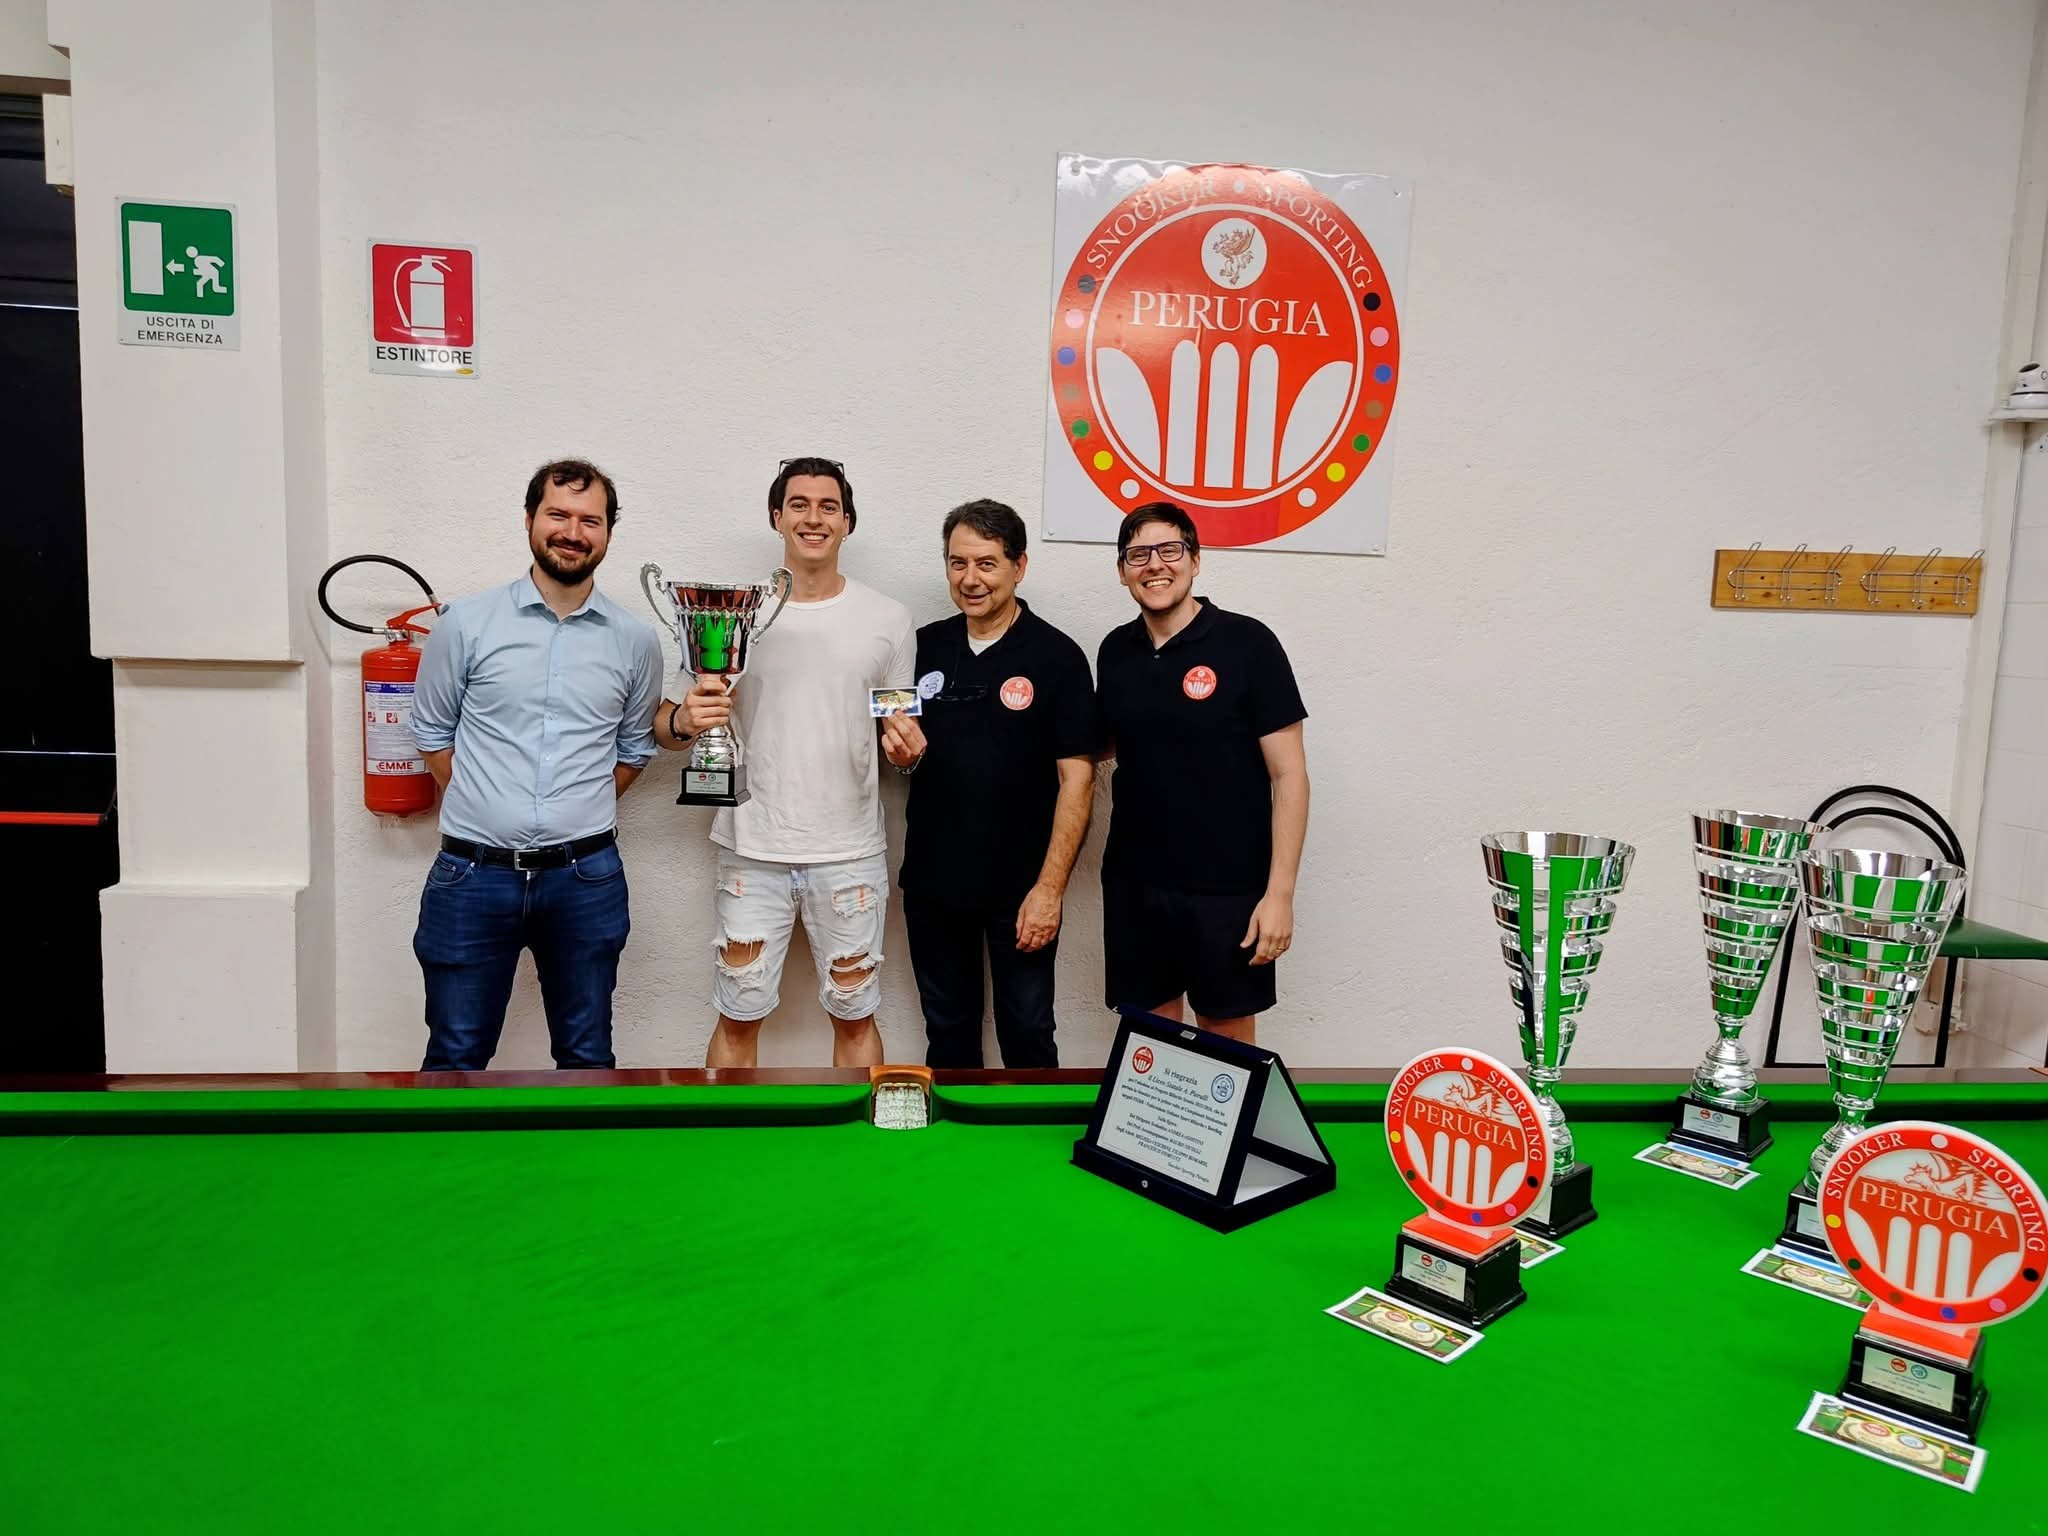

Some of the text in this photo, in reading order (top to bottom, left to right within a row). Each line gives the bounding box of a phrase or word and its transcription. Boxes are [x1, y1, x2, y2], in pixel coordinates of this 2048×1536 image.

[1086, 177, 1373, 290] SNOOKER SPORTING
[137, 330, 223, 345] EMERGENZA
[146, 316, 214, 330] USCITA DI
[1129, 290, 1329, 338] PERUGIA
[376, 346, 473, 365] ESTINTORE
[1390, 1056, 1543, 1162] SNOOKER SPORTING
[1413, 1101, 1518, 1151] PERUGIA
[1825, 1131, 2046, 1253] SNOOKER SPORTING
[1860, 1183, 2009, 1239] PERUGIA
